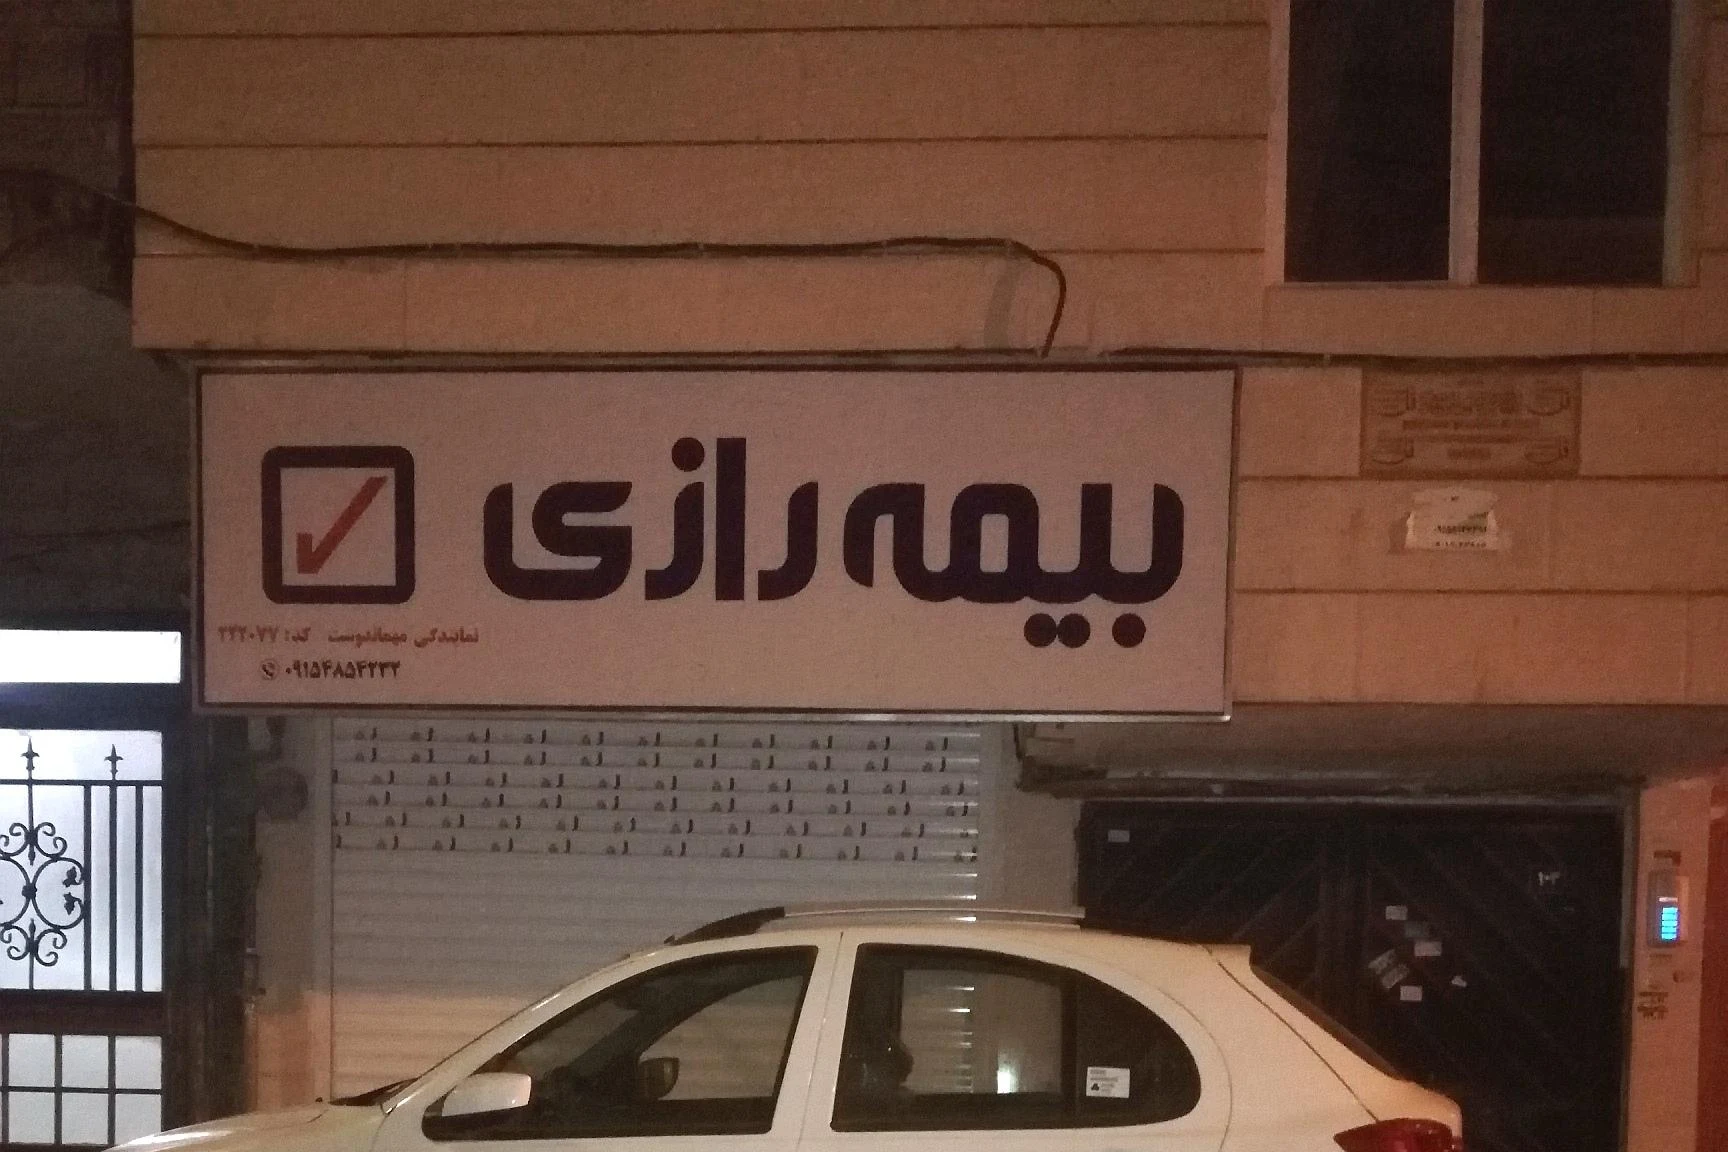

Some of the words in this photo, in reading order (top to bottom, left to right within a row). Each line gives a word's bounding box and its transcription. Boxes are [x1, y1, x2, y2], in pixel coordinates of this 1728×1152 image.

[483, 437, 819, 601] رازی
[843, 482, 1185, 649] بیمه
[413, 626, 479, 648] نمایندگی
